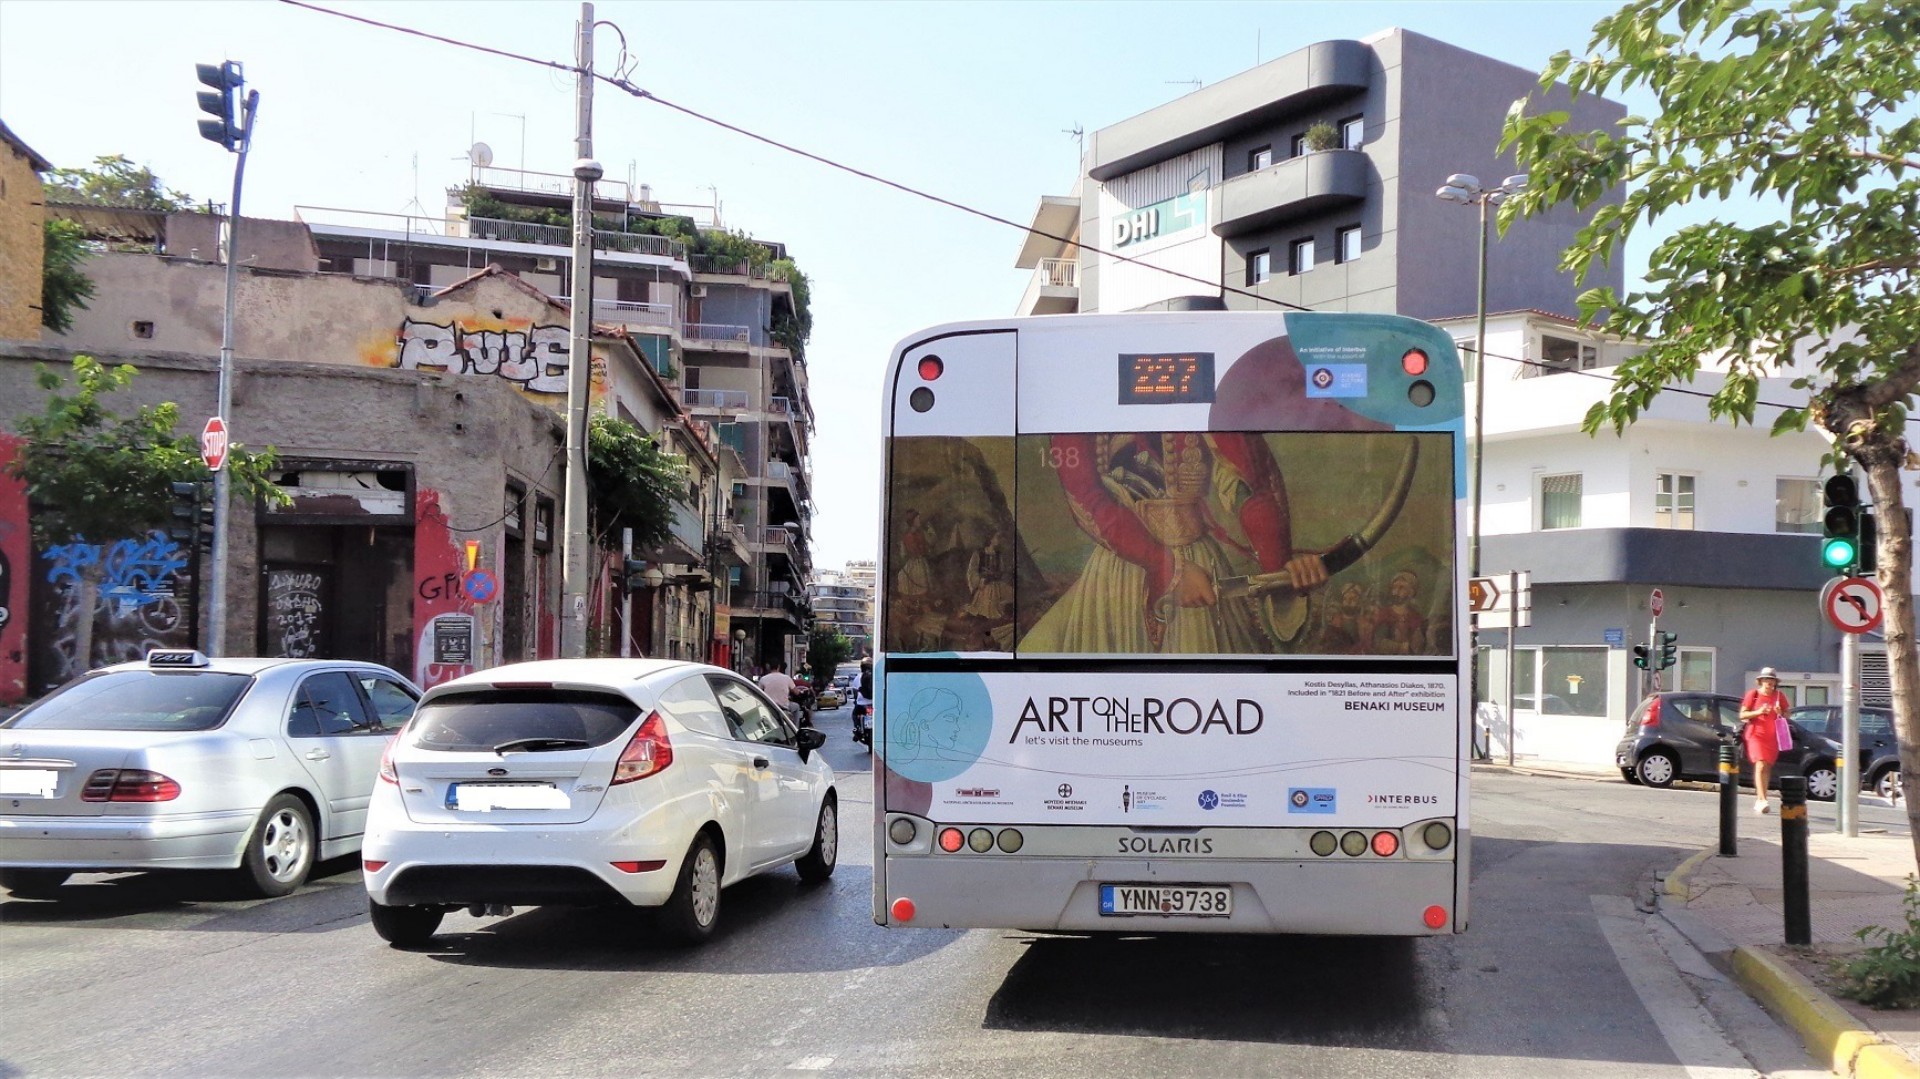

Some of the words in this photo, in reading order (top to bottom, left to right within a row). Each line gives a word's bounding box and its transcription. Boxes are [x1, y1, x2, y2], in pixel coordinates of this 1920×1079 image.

[1113, 208, 1159, 247] DHI
[1133, 357, 1197, 393] 227
[204, 431, 225, 457] STOP
[1039, 446, 1080, 468] 138
[151, 654, 192, 663] TAXI
[1327, 681, 1358, 689] Desyllas,
[1400, 682, 1426, 690] Diakos,
[1372, 690, 1386, 698] and
[1387, 690, 1409, 698] After"
[1410, 691, 1446, 699] exhibition
[1344, 701, 1390, 712] BENAKI
[1393, 702, 1446, 712] MUSEUM
[1008, 695, 1091, 745] ART
[1143, 697, 1264, 736] ROAD
[1025, 736, 1046, 745] let's
[1048, 736, 1069, 745] visit
[1072, 737, 1090, 746] the
[1092, 738, 1143, 747] museums
[1374, 795, 1438, 804] INTERBUS
[1118, 837, 1213, 854] SOLARIS
